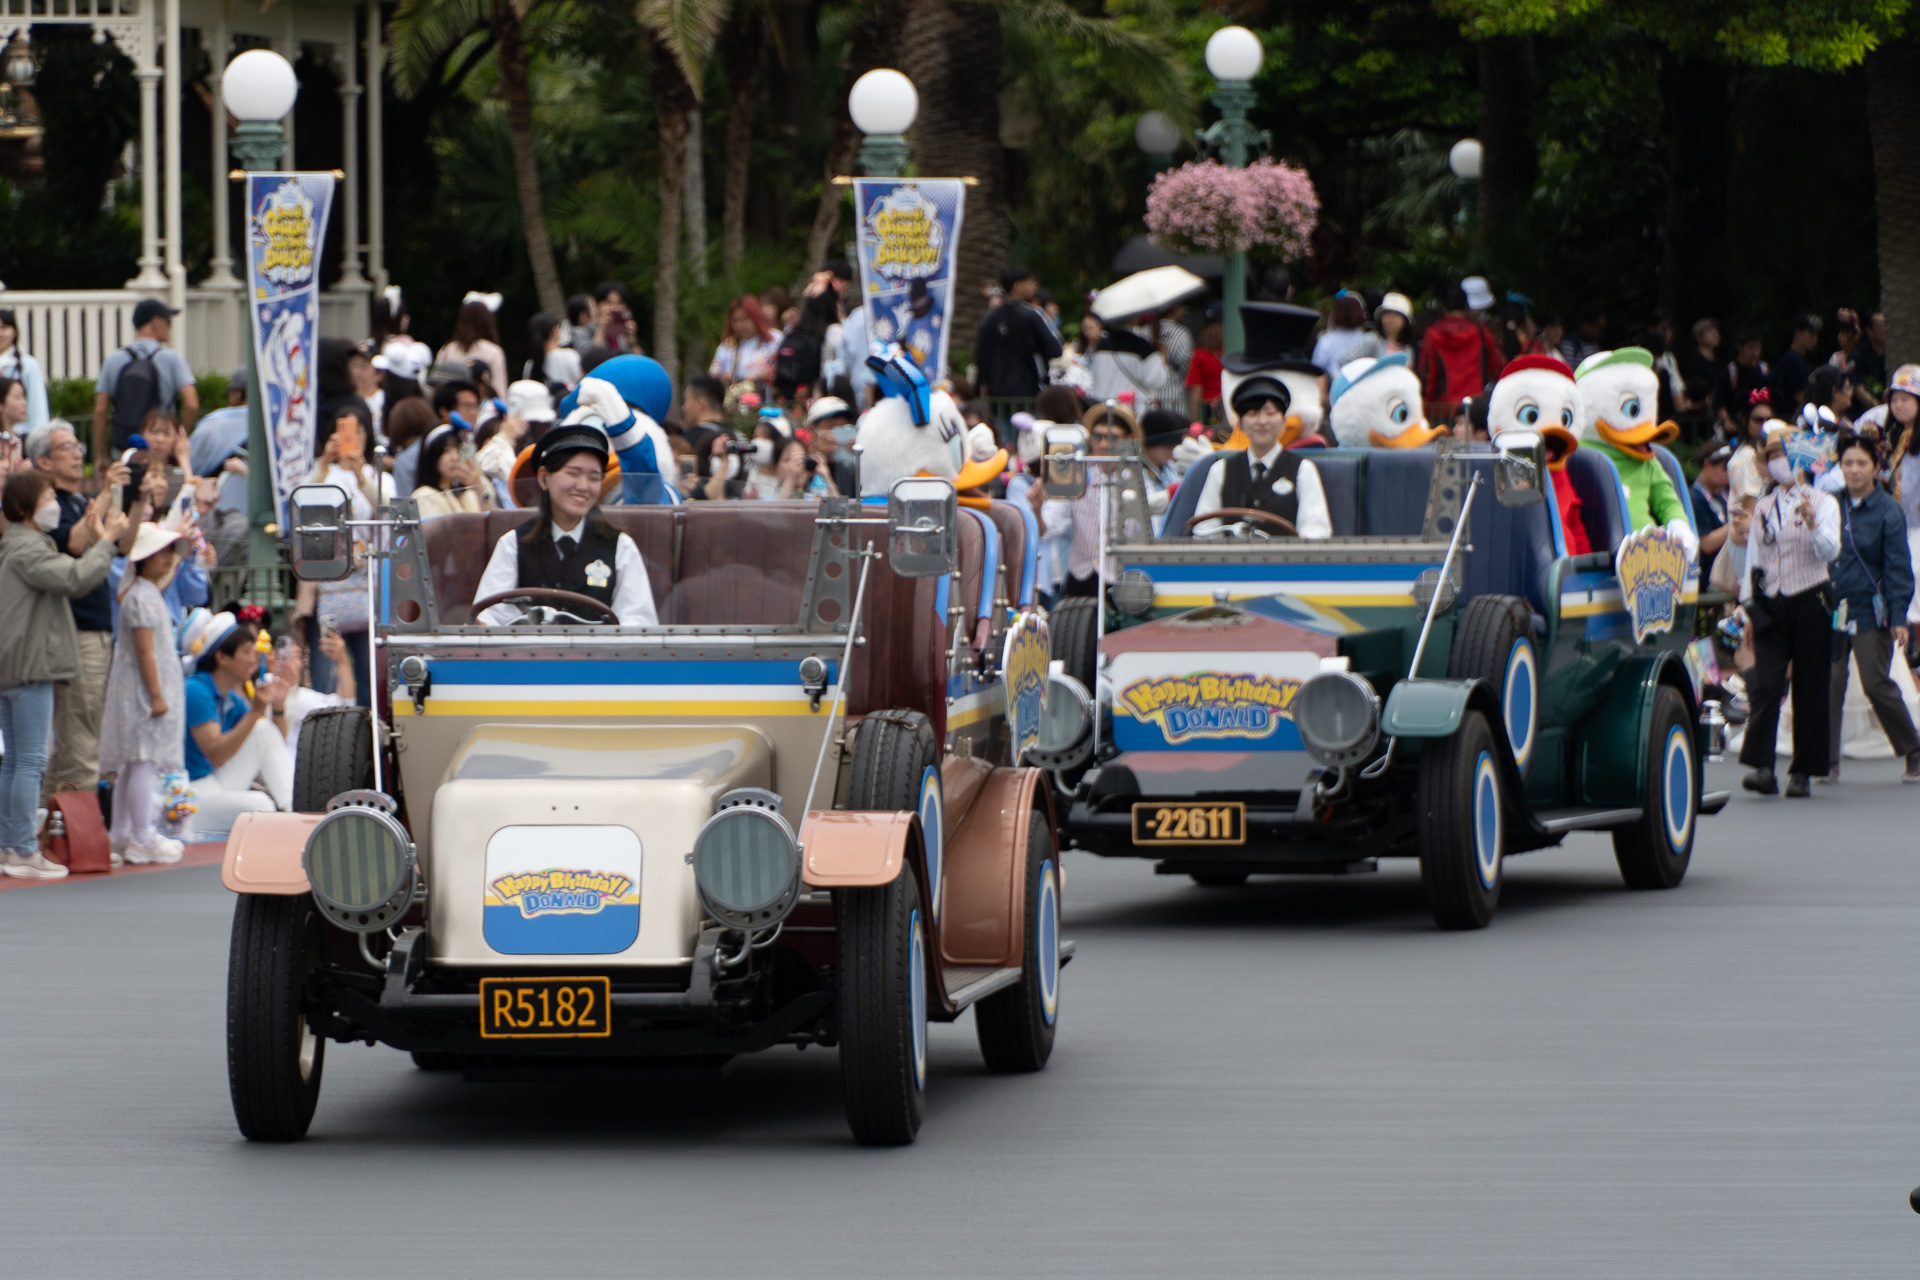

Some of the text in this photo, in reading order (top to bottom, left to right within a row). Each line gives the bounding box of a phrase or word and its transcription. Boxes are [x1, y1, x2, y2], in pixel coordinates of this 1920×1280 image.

[1125, 676, 1299, 713] Happy Birthday
[1165, 707, 1269, 737] DONALD
[495, 875, 549, 898] Happy
[523, 892, 599, 913] DONALD
[494, 987, 596, 1027] R5182
